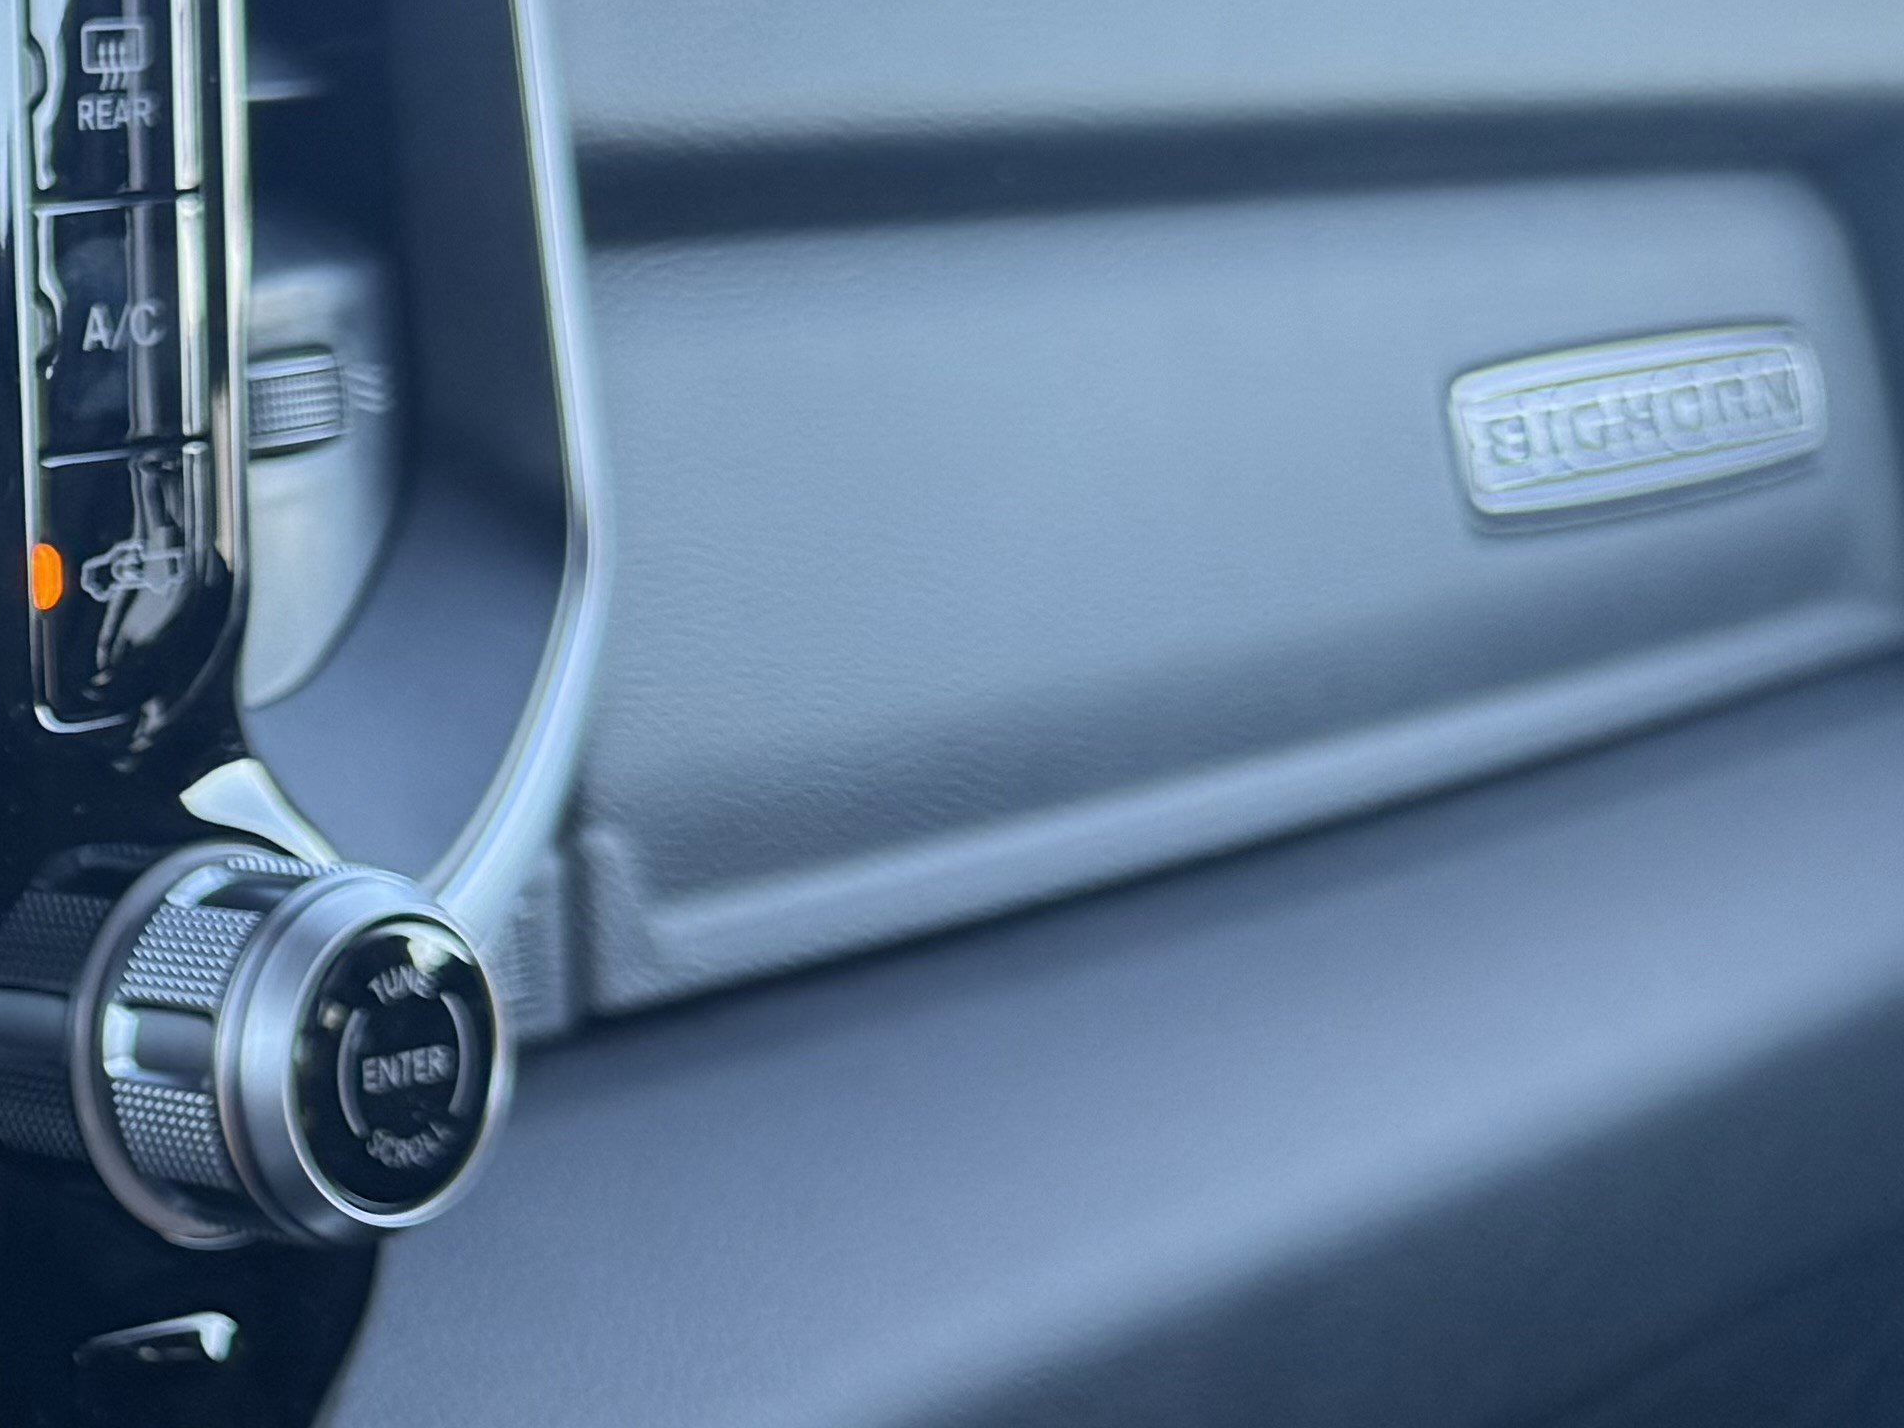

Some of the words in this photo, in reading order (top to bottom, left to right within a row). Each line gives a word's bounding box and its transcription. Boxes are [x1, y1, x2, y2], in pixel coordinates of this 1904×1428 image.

[77, 95, 157, 131] REAR
[83, 297, 168, 352] A/C
[362, 1044, 457, 1094] ENTER
